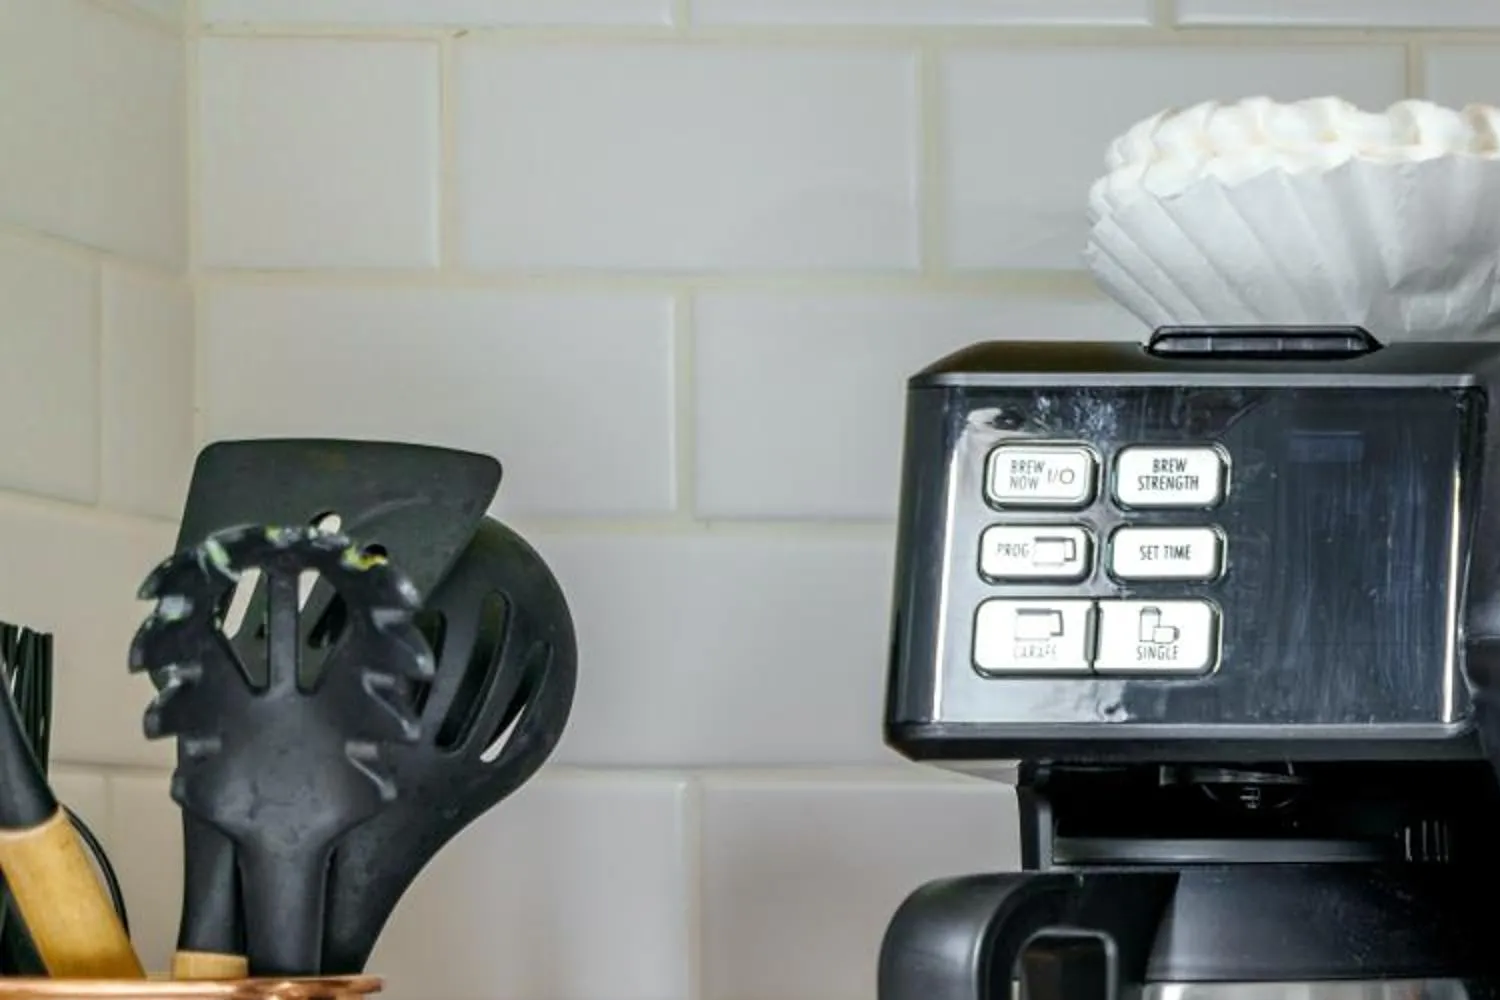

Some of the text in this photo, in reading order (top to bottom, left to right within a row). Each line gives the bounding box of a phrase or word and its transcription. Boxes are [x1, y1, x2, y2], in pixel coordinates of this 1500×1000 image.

[1010, 459, 1046, 474] BREW
[1152, 458, 1187, 473] BREW
[1009, 475, 1040, 490] NOW
[1137, 475, 1200, 491] STRENGTH
[1139, 545, 1191, 560] SET TIME
[1136, 645, 1179, 661] SINGLE
